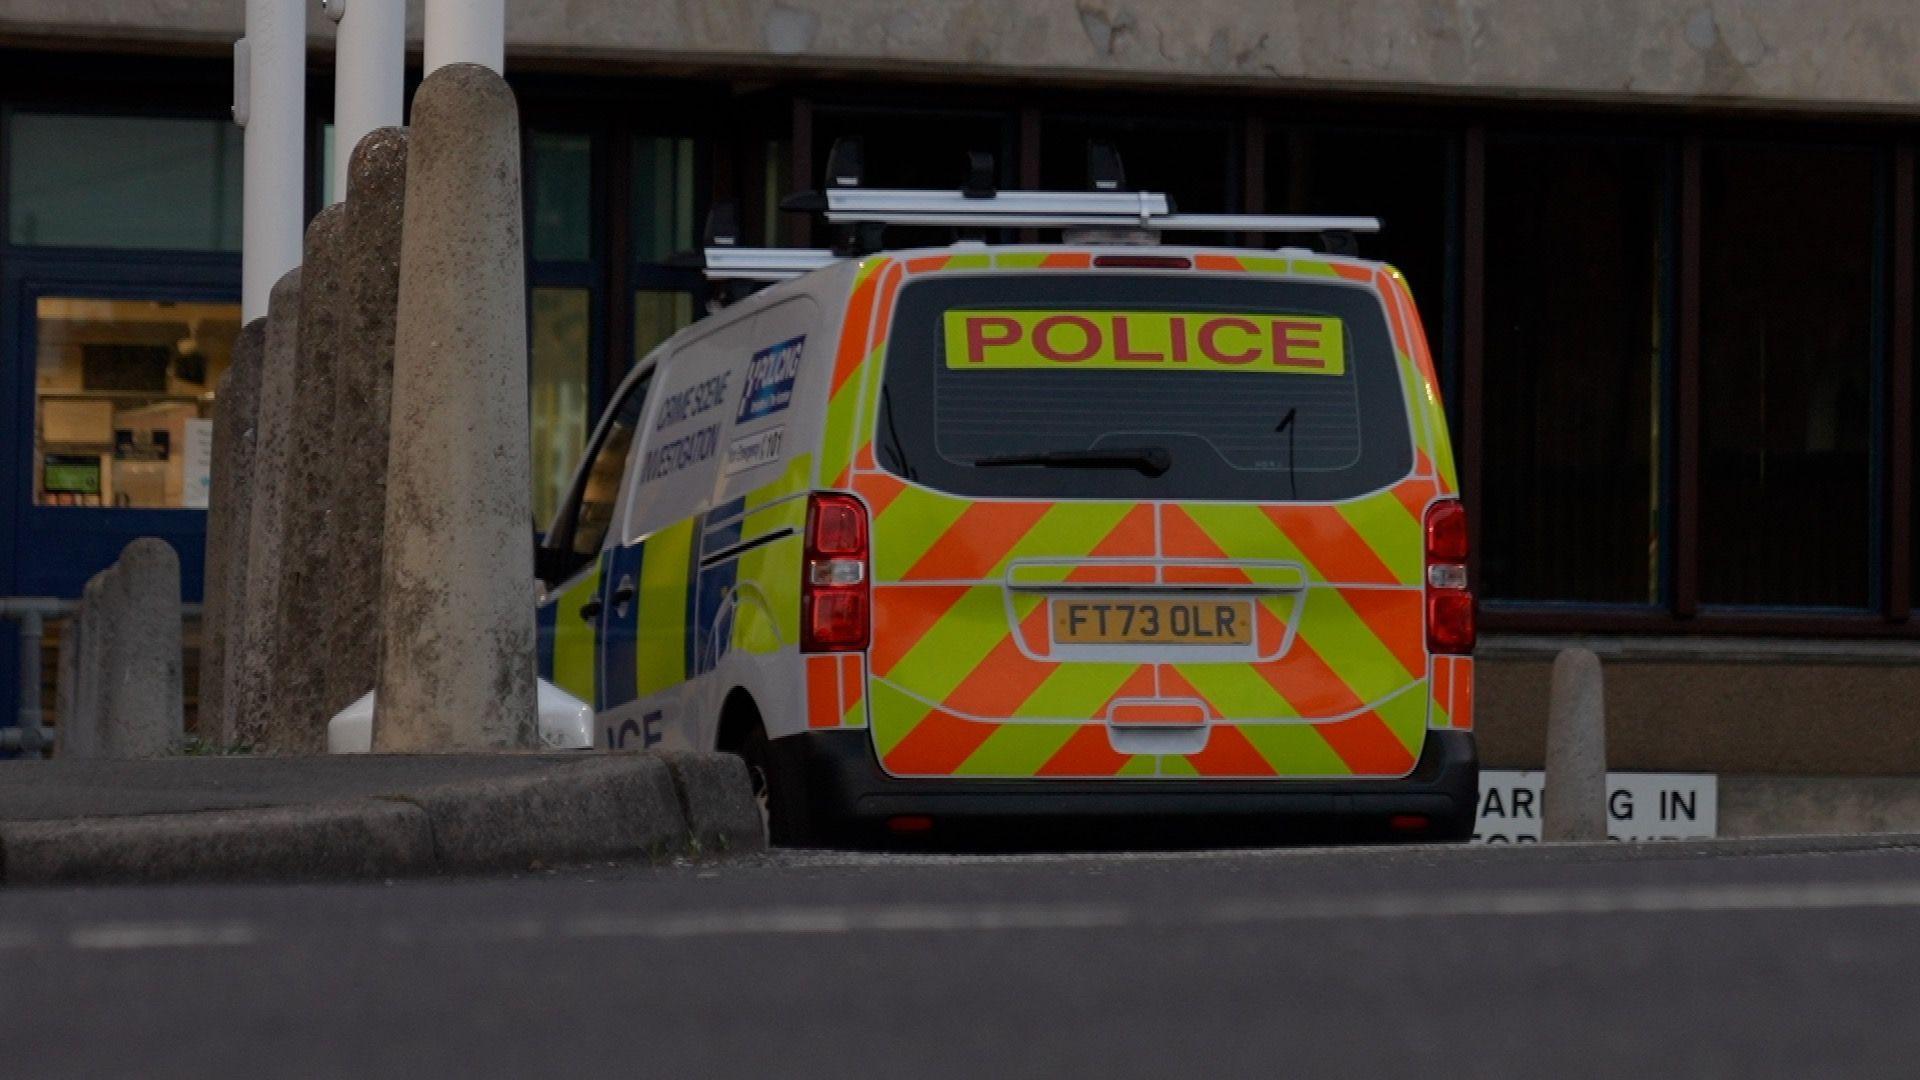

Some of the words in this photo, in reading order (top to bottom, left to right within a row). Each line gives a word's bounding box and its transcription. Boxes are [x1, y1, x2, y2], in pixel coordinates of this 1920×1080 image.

[965, 315, 1326, 368] POLICE
[656, 386, 695, 430] CRIME
[691, 370, 731, 415] SCENE
[641, 422, 721, 483] INVESTIGATION
[1068, 605, 1160, 637] FT73
[1170, 605, 1236, 637] OLR
[1660, 790, 1696, 820] IN
